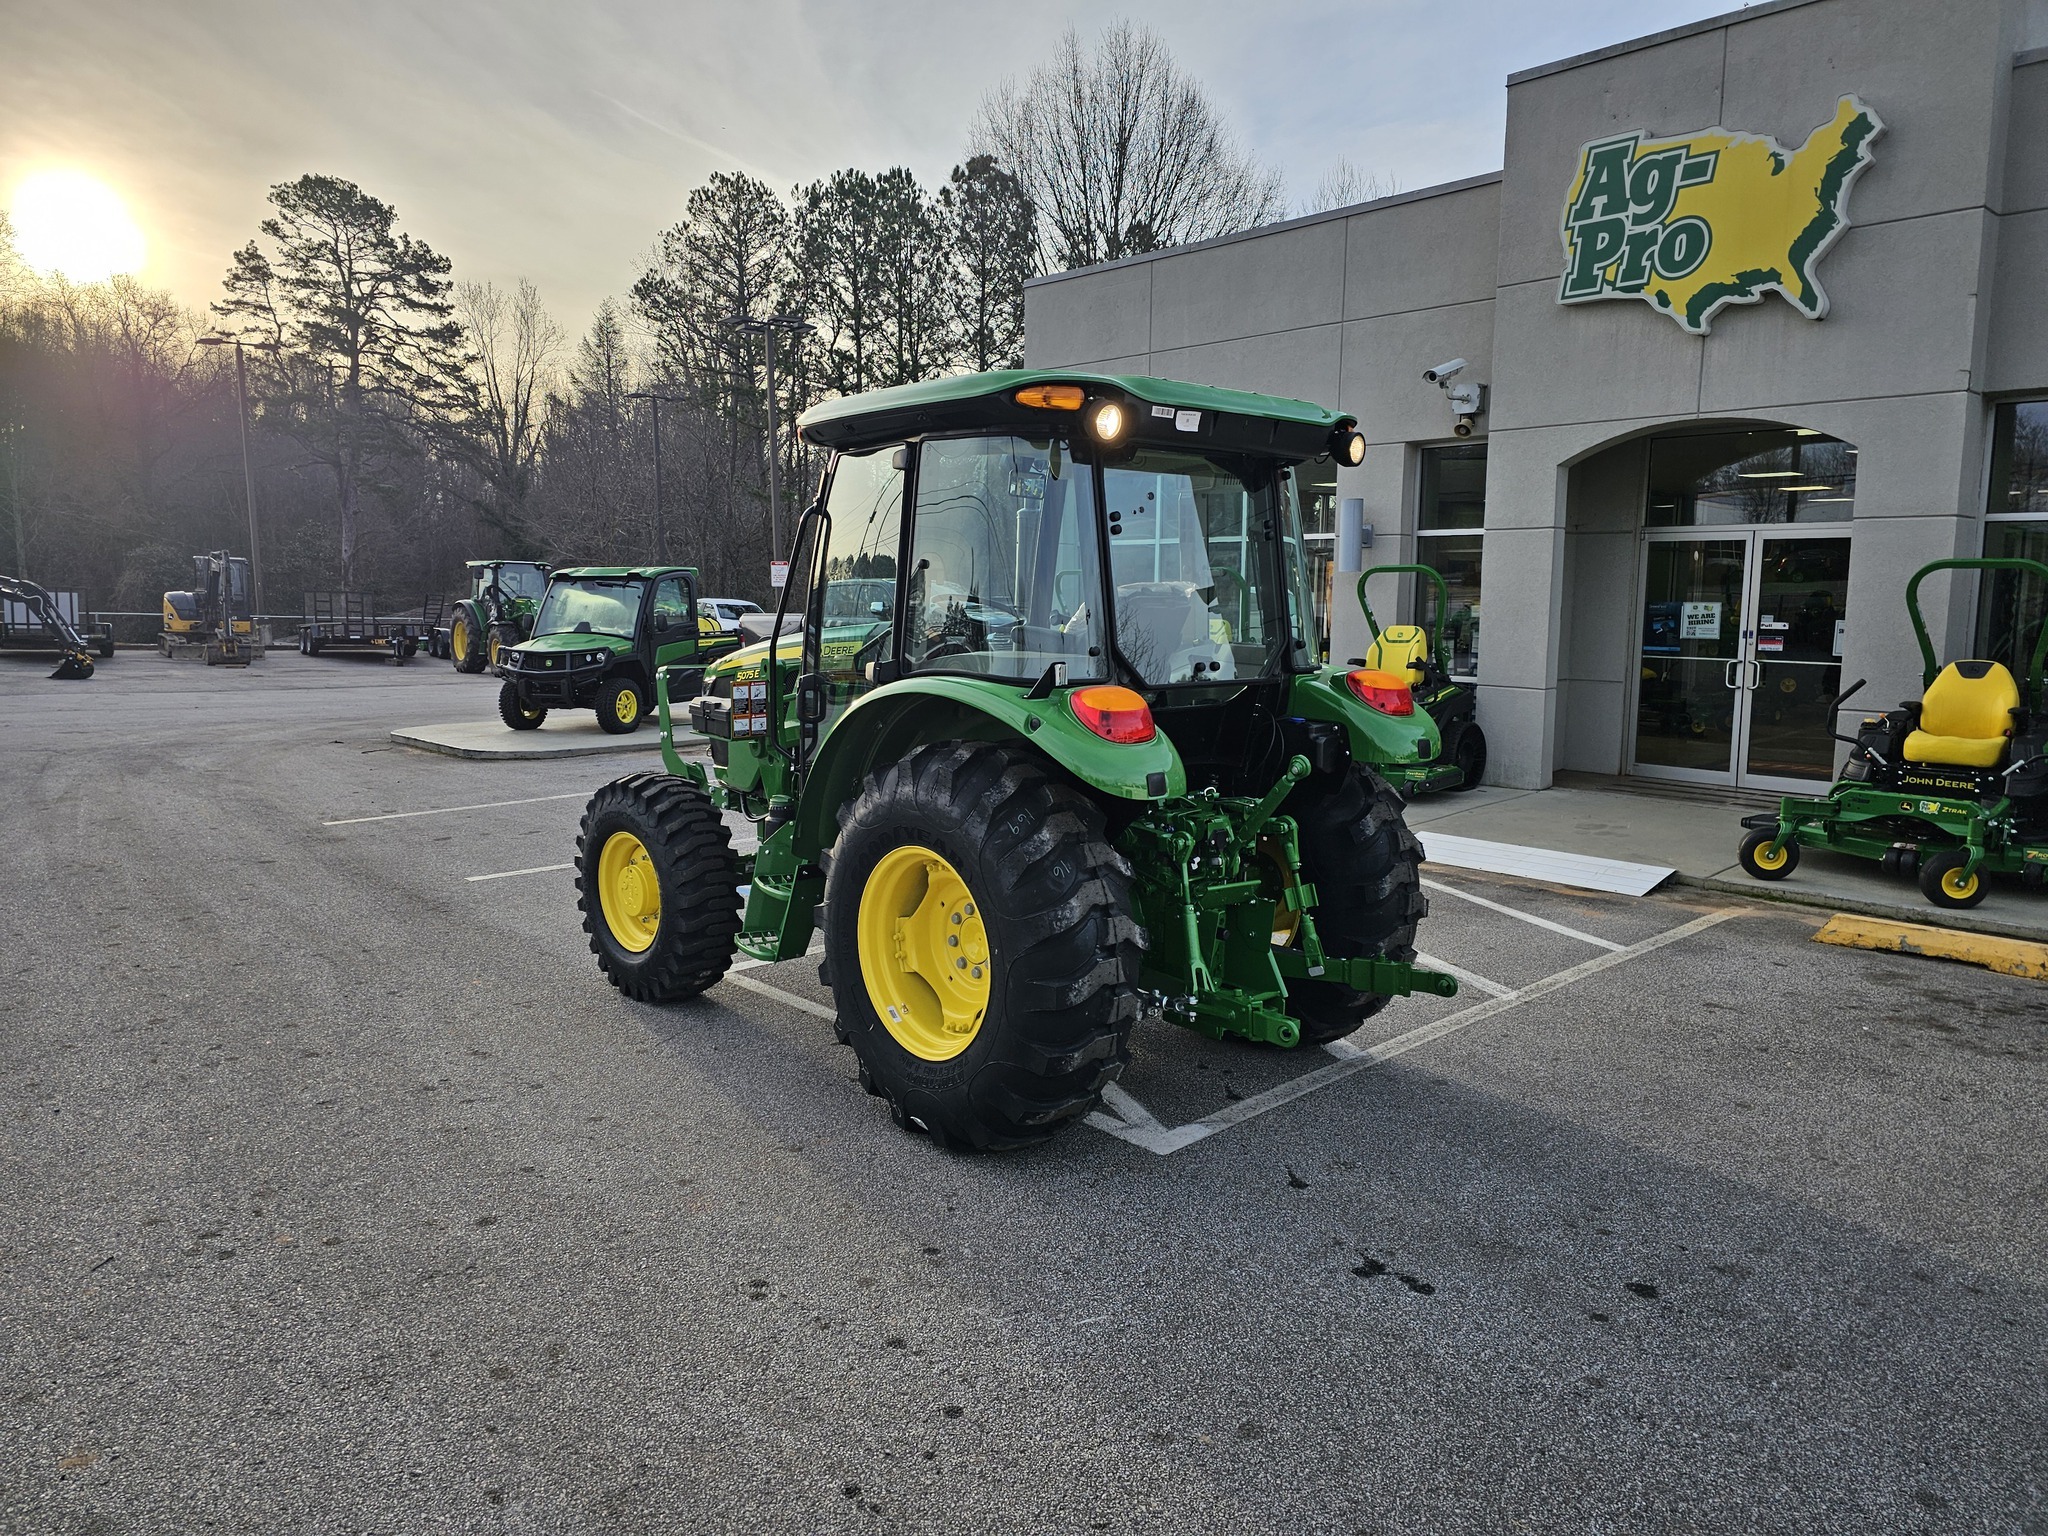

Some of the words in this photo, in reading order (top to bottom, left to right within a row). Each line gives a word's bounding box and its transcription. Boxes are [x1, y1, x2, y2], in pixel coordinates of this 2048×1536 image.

[1566, 136, 1720, 229] Ag-
[1561, 215, 1712, 300] Pro
[823, 645, 855, 656] DEERE
[1902, 775, 1933, 786] JOHN
[1935, 778, 1975, 790] DEERE
